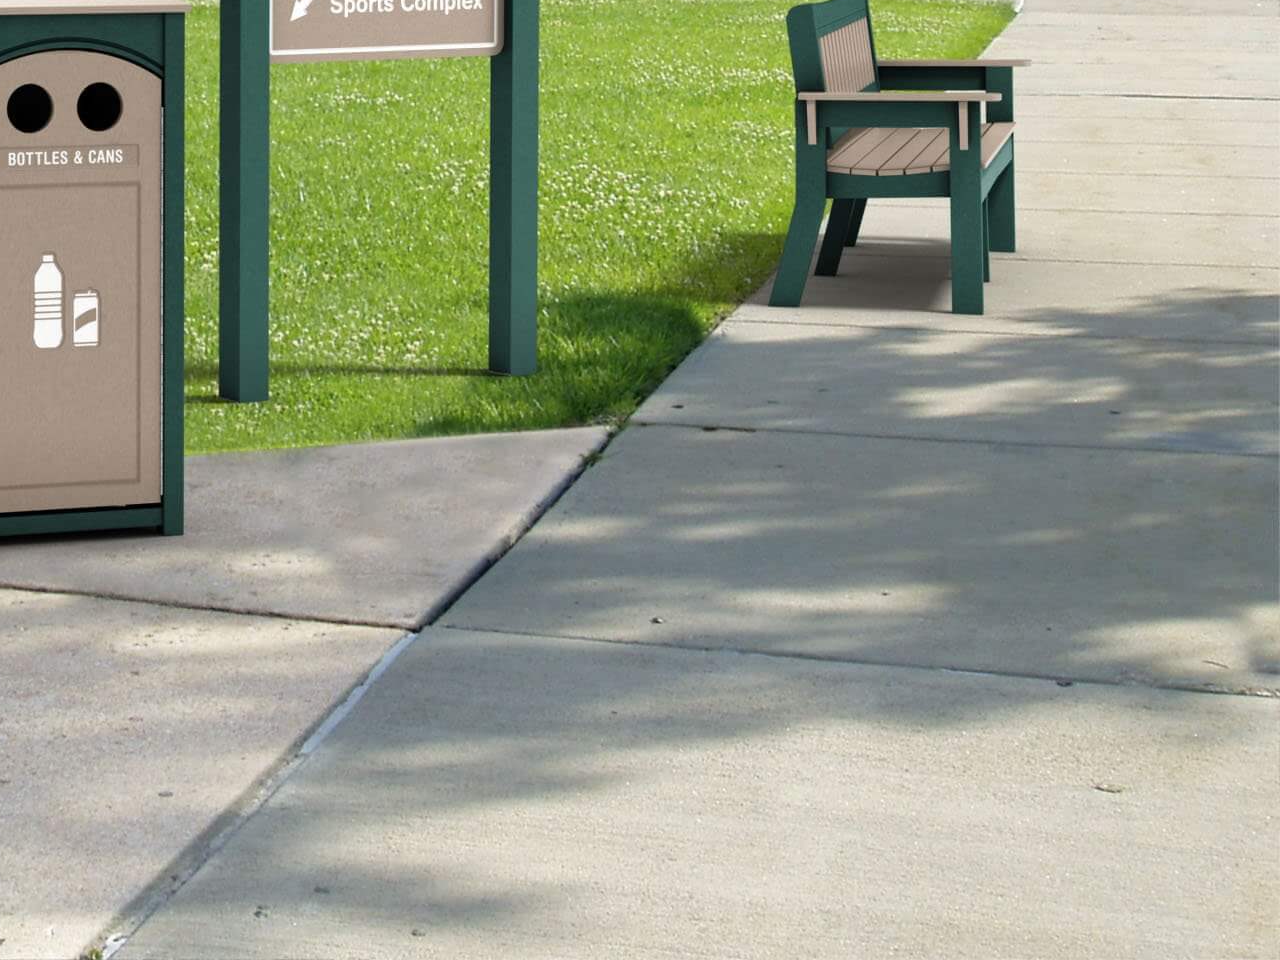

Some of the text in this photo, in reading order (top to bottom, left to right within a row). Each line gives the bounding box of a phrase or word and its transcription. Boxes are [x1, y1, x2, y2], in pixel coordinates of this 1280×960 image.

[8, 148, 124, 166] BOTTLES & CANS
